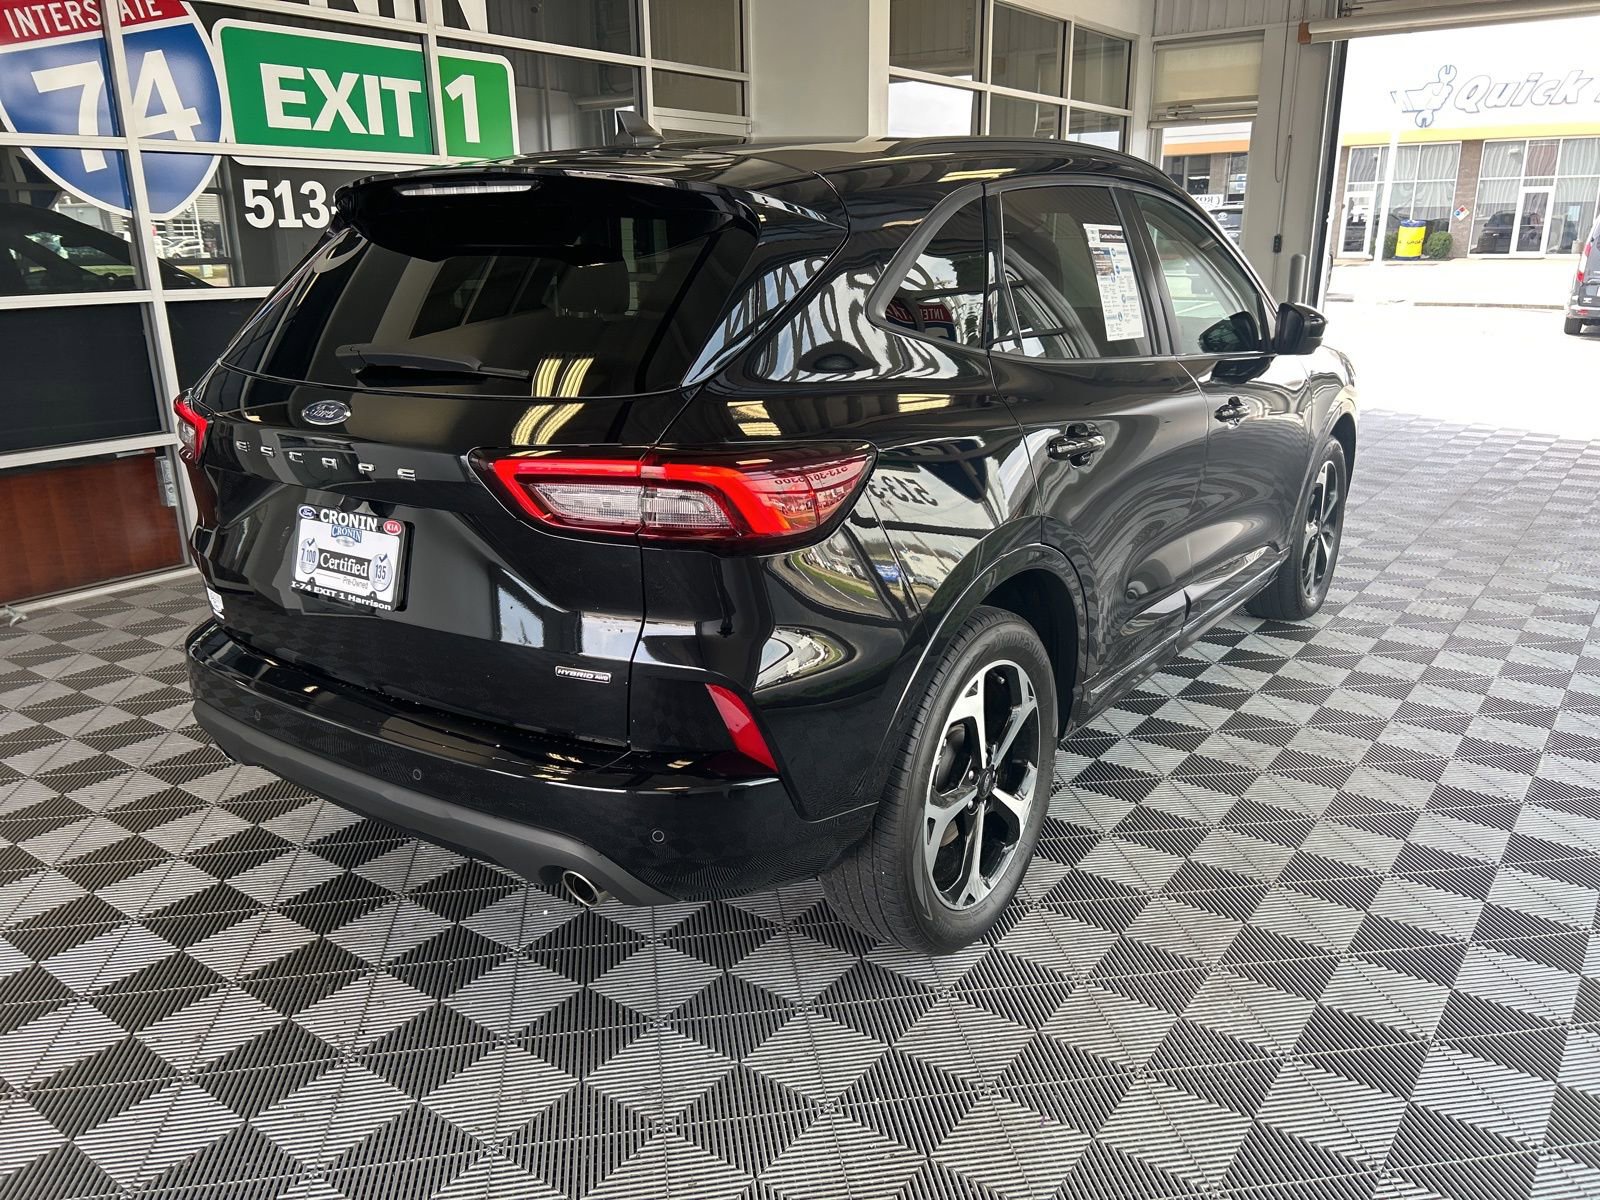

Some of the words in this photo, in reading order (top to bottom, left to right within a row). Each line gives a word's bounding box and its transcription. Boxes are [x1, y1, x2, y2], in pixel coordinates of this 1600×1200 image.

[4, 0, 163, 39] INTERSATE
[260, 62, 422, 138] EXIT
[445, 74, 481, 143] 1
[1454, 69, 1595, 114] Quick
[31, 49, 201, 173] 74
[309, 404, 339, 419] Ford
[236, 440, 416, 481] ESCAPE
[320, 508, 378, 532] CRONIN
[386, 523, 399, 532] KIA
[331, 525, 362, 543] CRONIN
[320, 552, 368, 577] Certified
[375, 563, 387, 580] 135
[342, 575, 369, 590] Pre-Owned
[291, 581, 312, 592] I-74
[314, 586, 338, 598] EXIT
[347, 594, 392, 611] Harrison
[557, 668, 594, 679] HYBRID
